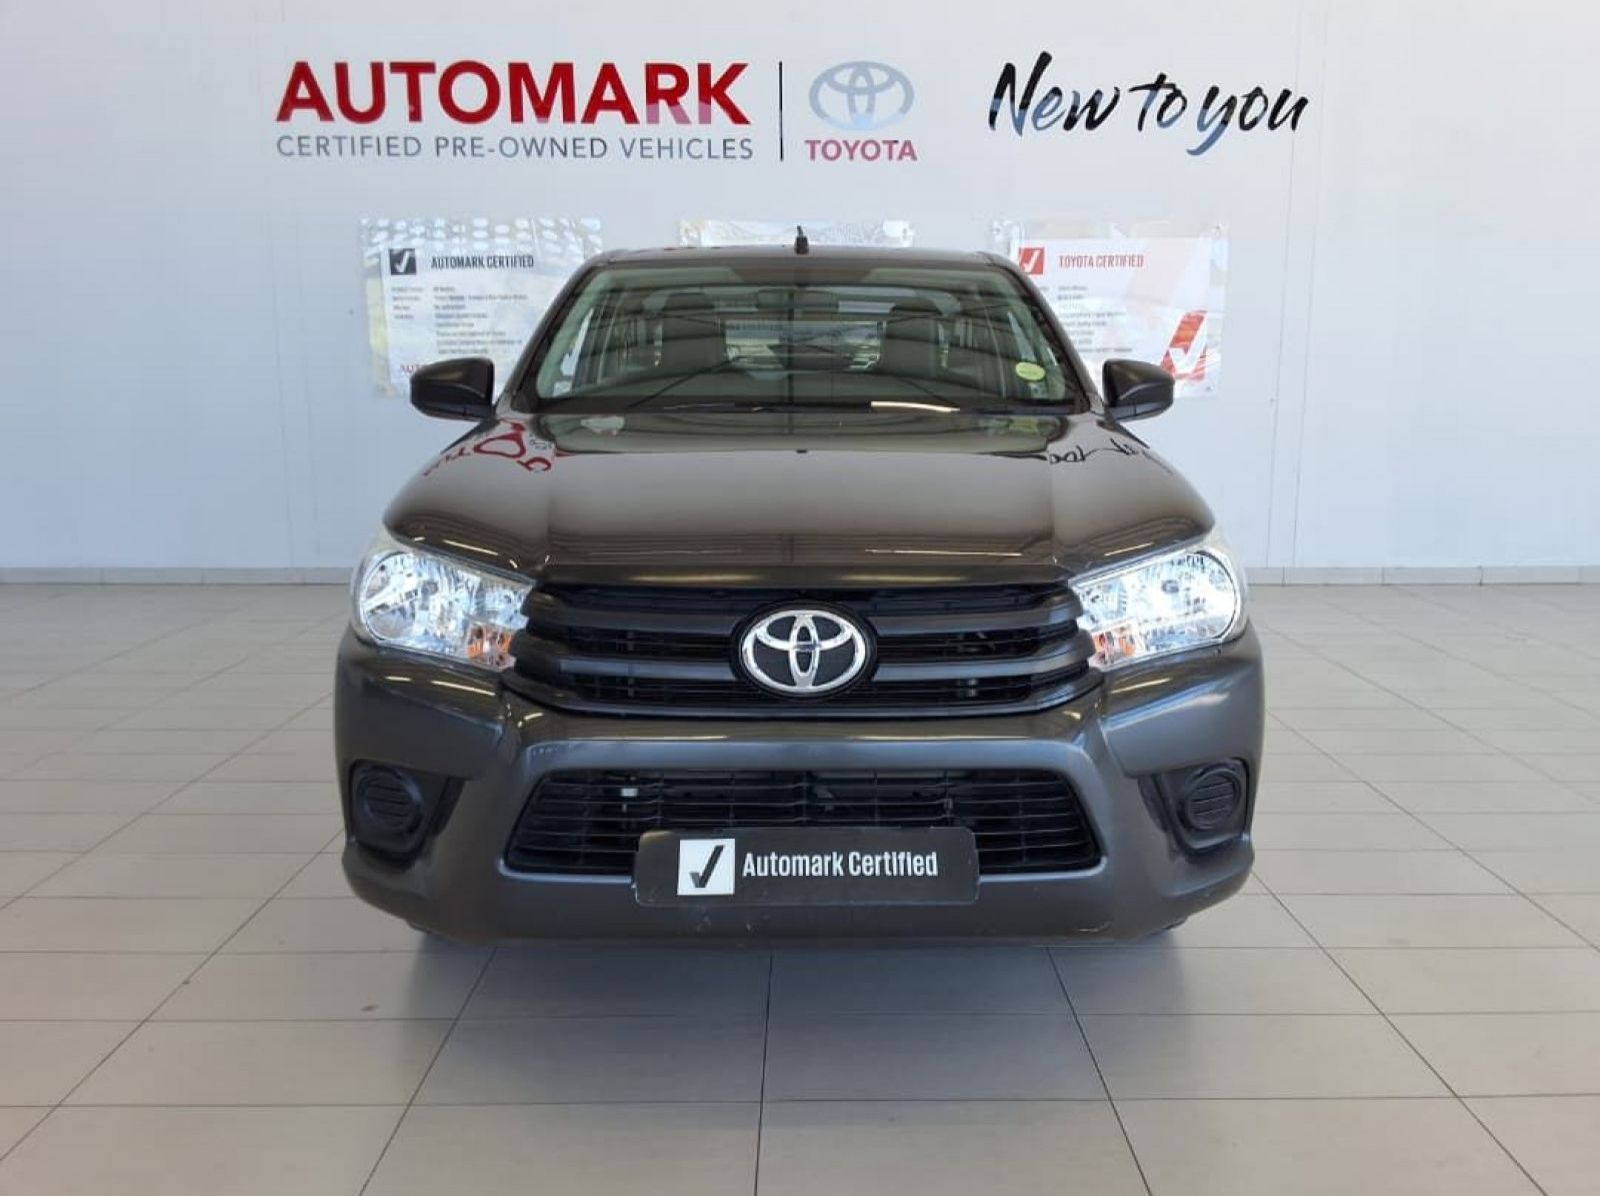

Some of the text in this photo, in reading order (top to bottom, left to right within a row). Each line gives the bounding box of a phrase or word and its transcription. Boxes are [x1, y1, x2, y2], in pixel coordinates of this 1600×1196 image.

[275, 60, 752, 126] AUTOMARK
[987, 50, 1309, 156] New to you
[276, 135, 754, 160] CERTIFIED PRE-OWNED VEHICLES
[804, 138, 918, 162] TOYOTA
[431, 254, 534, 269] AUTOMARK CERTIFIED
[1059, 254, 1144, 268] TOYOTA CERTIFIED
[742, 851, 939, 877] Automark Certified
